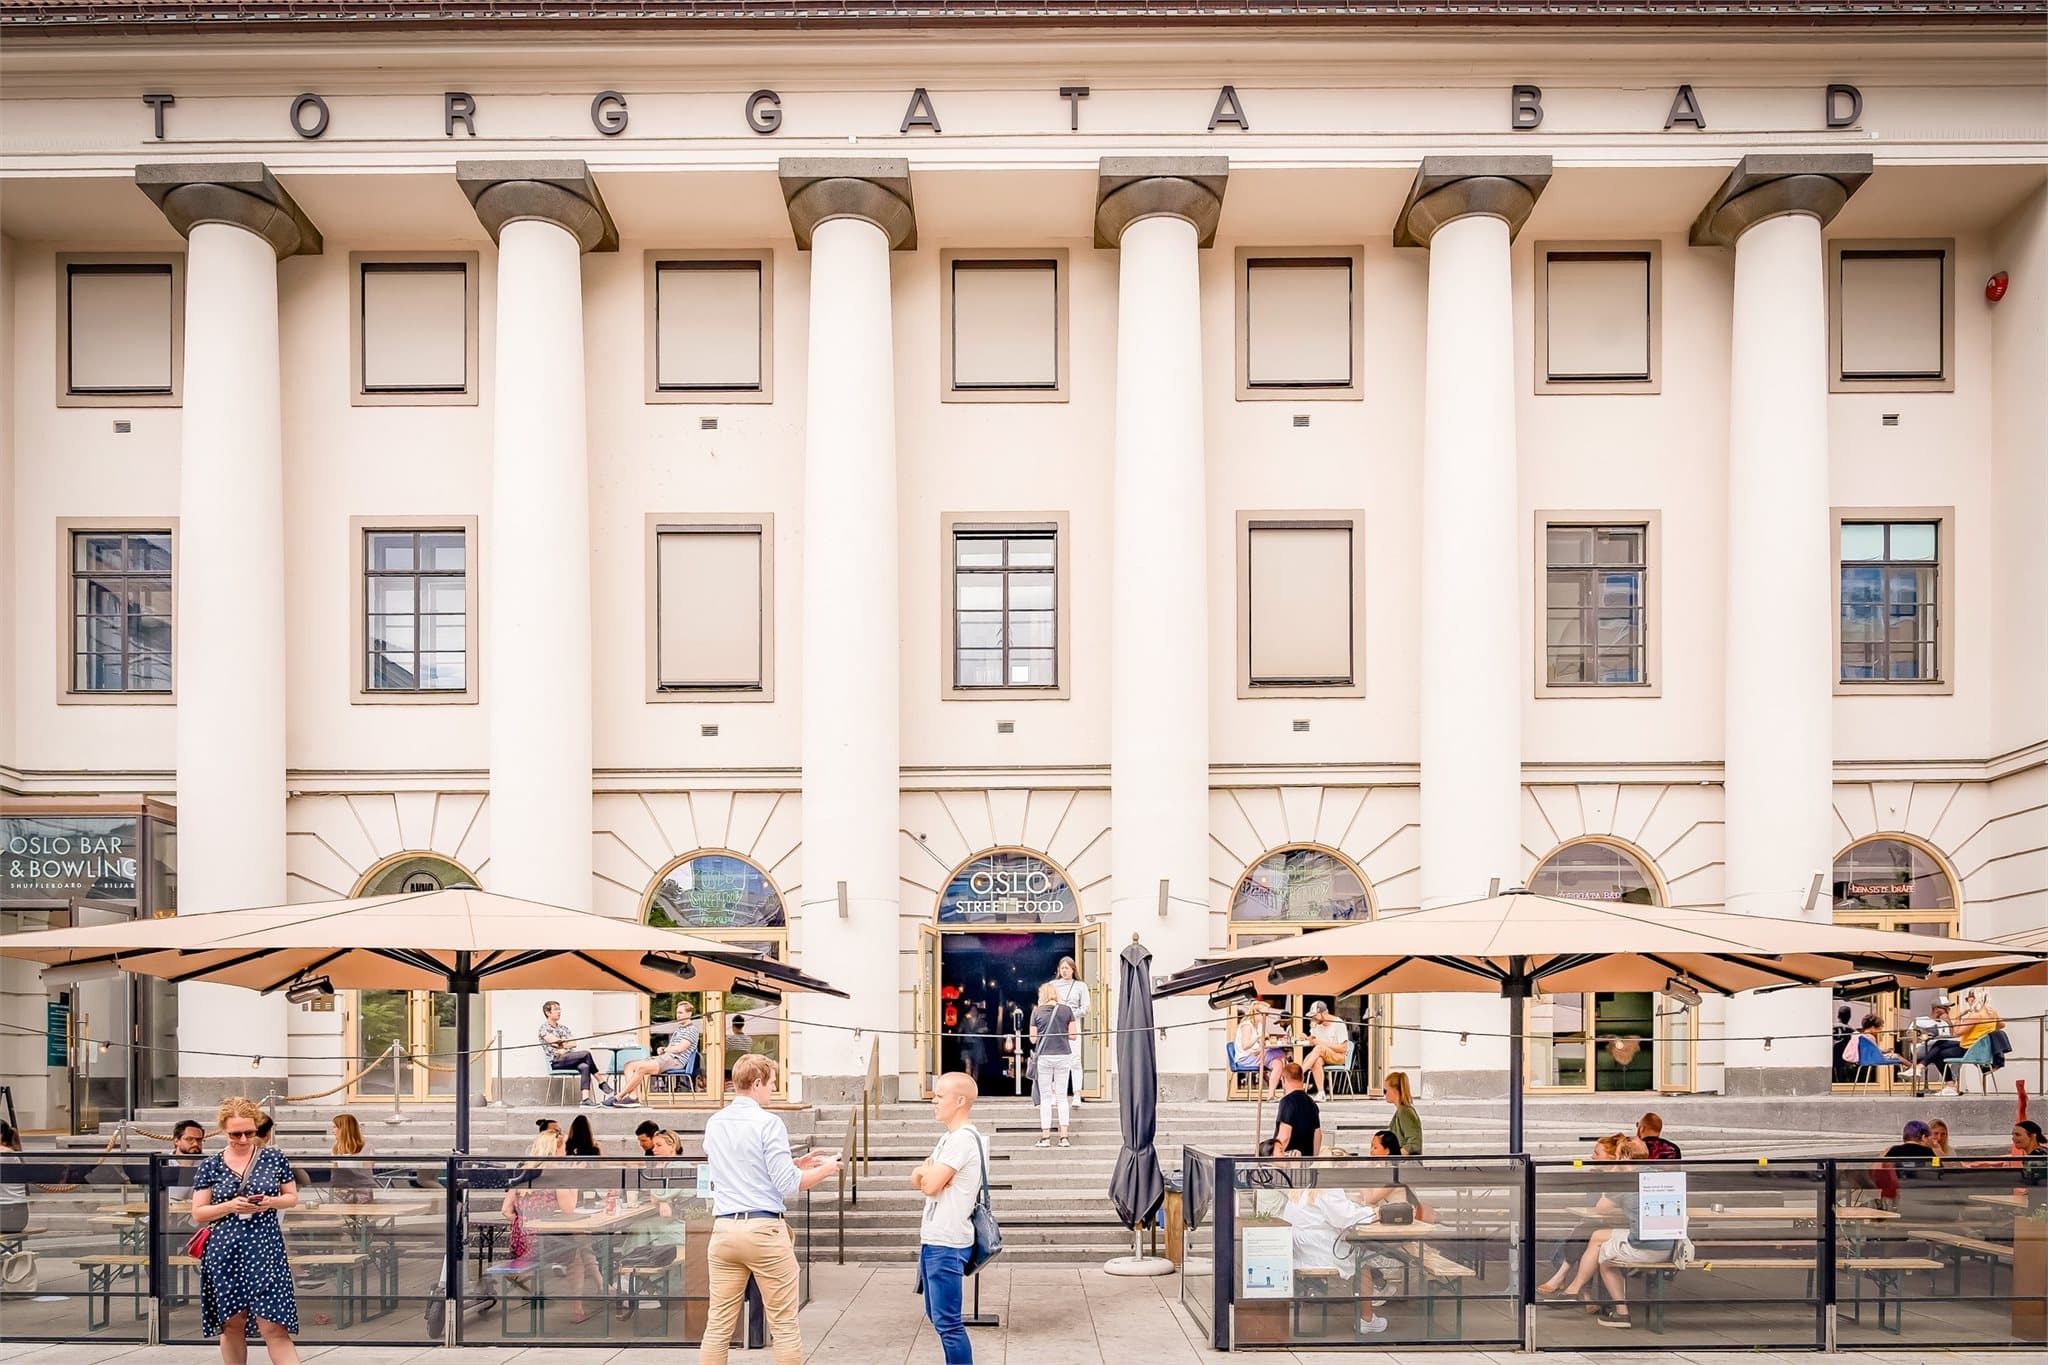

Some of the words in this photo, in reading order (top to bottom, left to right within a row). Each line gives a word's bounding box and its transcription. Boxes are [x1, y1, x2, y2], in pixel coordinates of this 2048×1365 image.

[142, 85, 1249, 138] TORGGATA
[1511, 84, 1863, 129] BAD
[9, 836, 71, 855] OSLO
[80, 836, 122, 854] BAR
[9, 859, 25, 878] &
[30, 855, 137, 878] BOWLING
[970, 871, 1049, 895] OSLO
[956, 900, 1009, 913] STREET
[1015, 900, 1063, 913] FOOD
